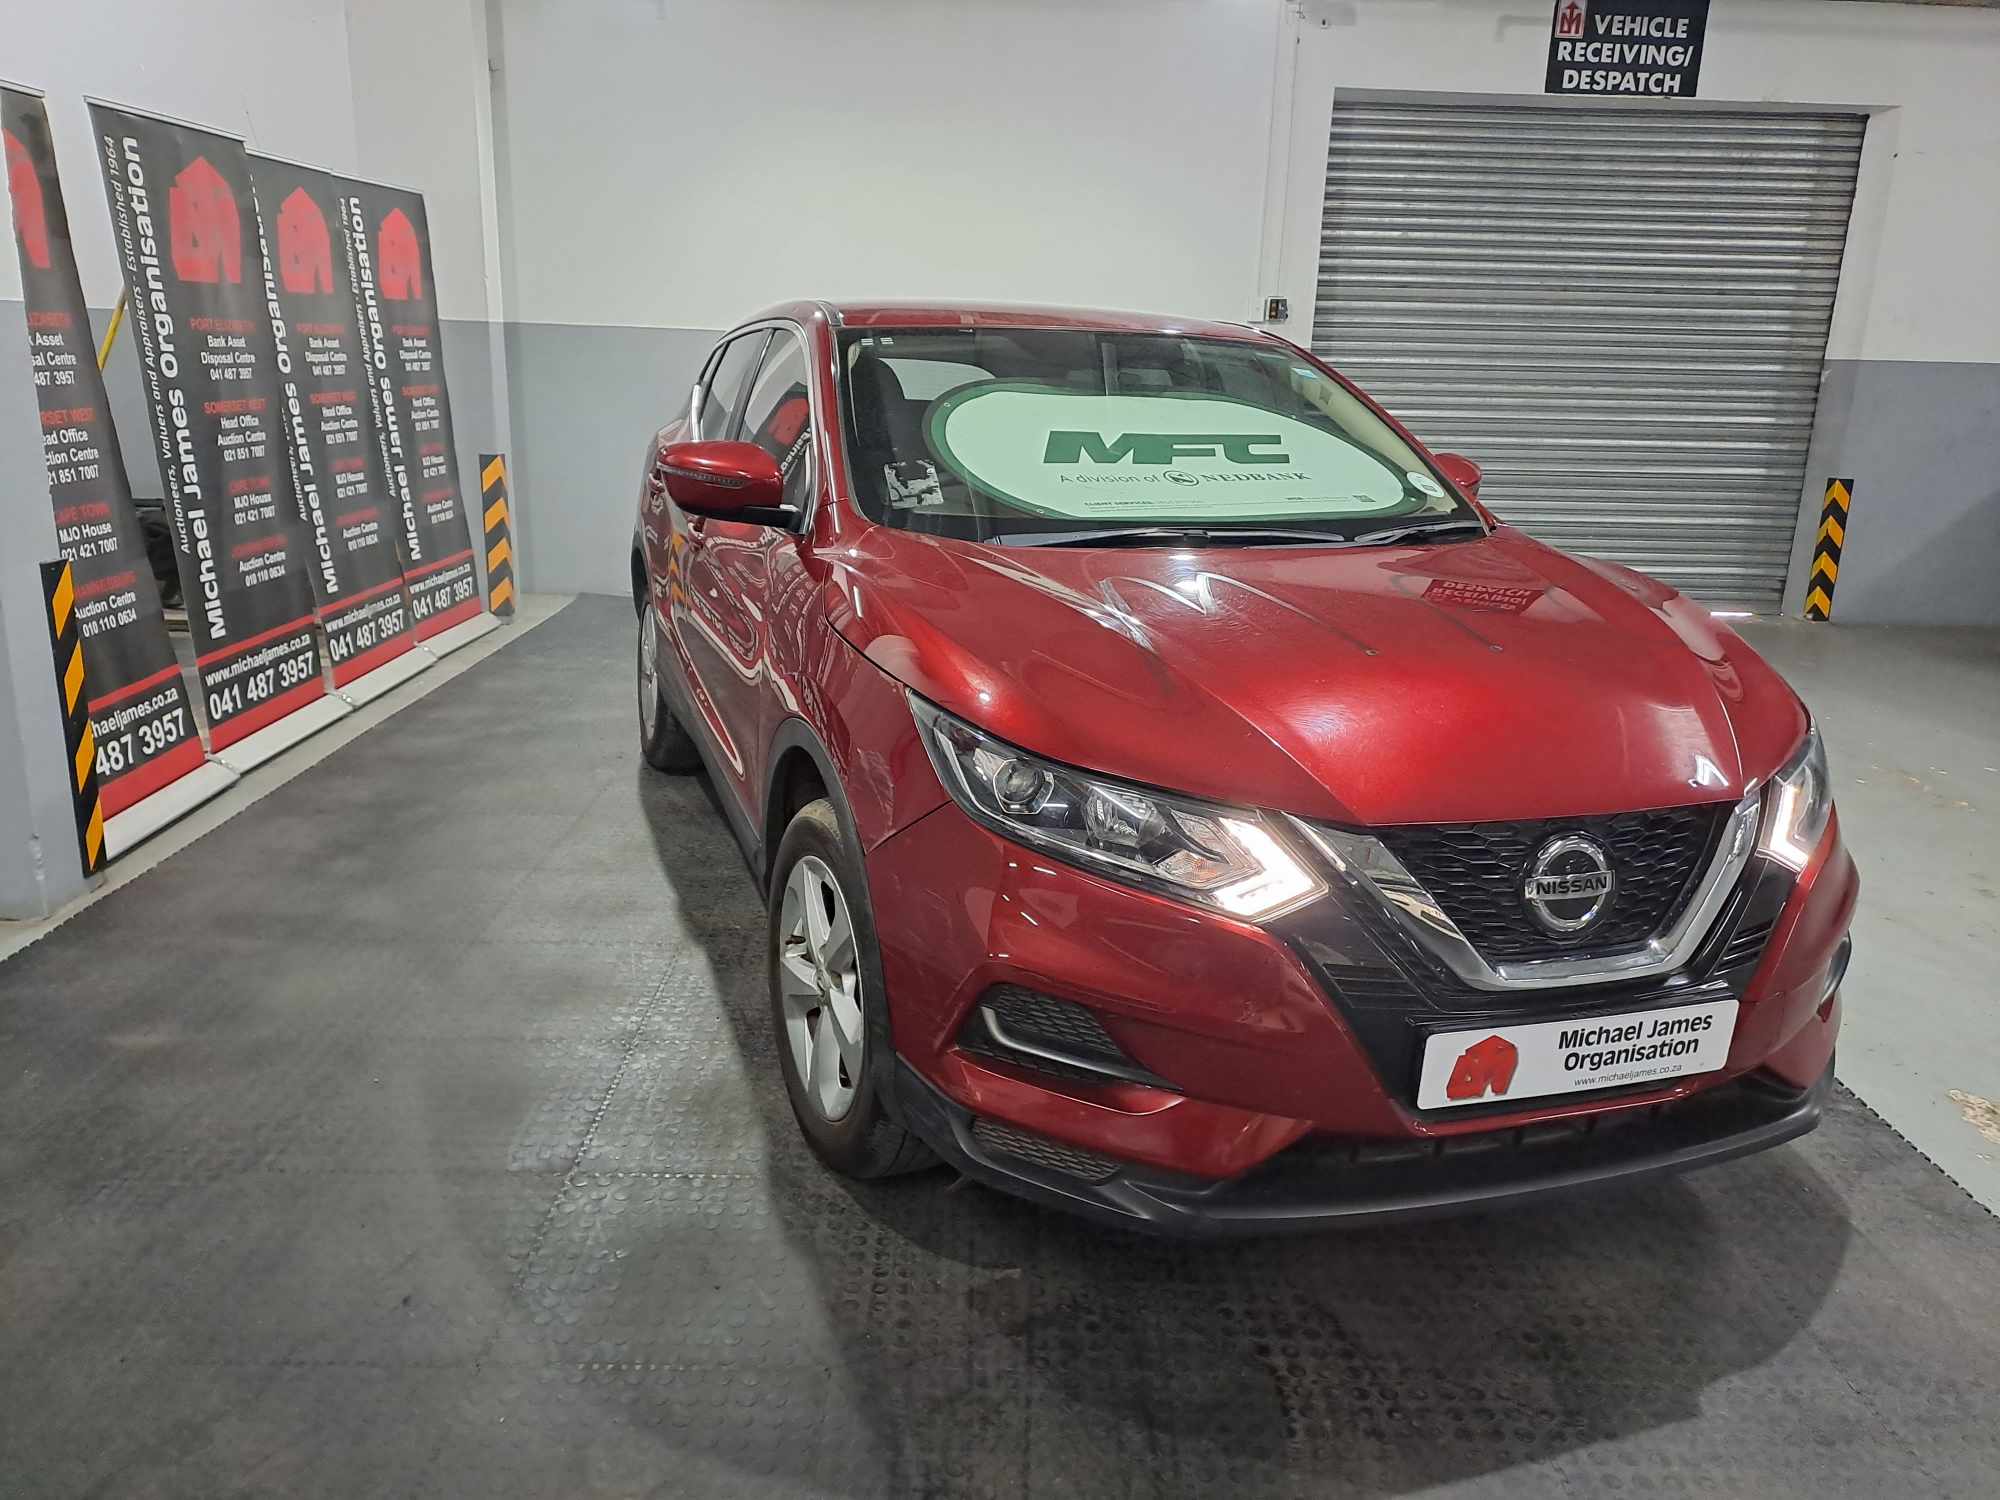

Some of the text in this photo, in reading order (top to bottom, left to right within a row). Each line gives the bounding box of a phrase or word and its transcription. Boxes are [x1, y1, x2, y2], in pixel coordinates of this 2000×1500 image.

[1594, 14, 1690, 39] VEHICLE
[1557, 41, 1694, 67] RECEIVING/
[1562, 69, 1681, 94] DESPATCH
[103, 135, 121, 176] 1964
[110, 179, 137, 272] Established
[35, 332, 64, 346] Asset
[133, 285, 155, 368] Appraisers
[47, 352, 77, 366] Centre
[53, 371, 75, 385] 3957
[122, 136, 227, 640] Michael James Organisation
[147, 369, 161, 401] and
[349, 197, 422, 560] Michael James Organisation
[60, 428, 88, 443] Office
[156, 403, 172, 459] Valuers
[285, 382, 314, 476] James
[69, 447, 99, 462] Centre
[1043, 430, 1290, 464] MFC
[58, 467, 77, 483] 851
[78, 465, 99, 481] 7007
[1076, 470, 1140, 484] division
[1199, 471, 1312, 481] NEDBANK
[59, 522, 112, 543] MJO House
[303, 484, 339, 594] Michael
[80, 542, 97, 559] 421
[98, 537, 118, 554] 7007
[109, 591, 137, 610] Centre
[412, 576, 473, 619] 041 487 3957
[100, 615, 117, 632] 110
[117, 607, 137, 626] 0634
[330, 609, 404, 661] 041 487 3957
[209, 651, 313, 720] 041 487 3957
[95, 707, 185, 776] 487 3957
[1536, 876, 1607, 894] NISSAN
[1558, 1014, 1713, 1049] Michael James
[1564, 1038, 1699, 1071] Organisation
[1574, 1063, 1682, 1086] www.michaeljames.co.za
